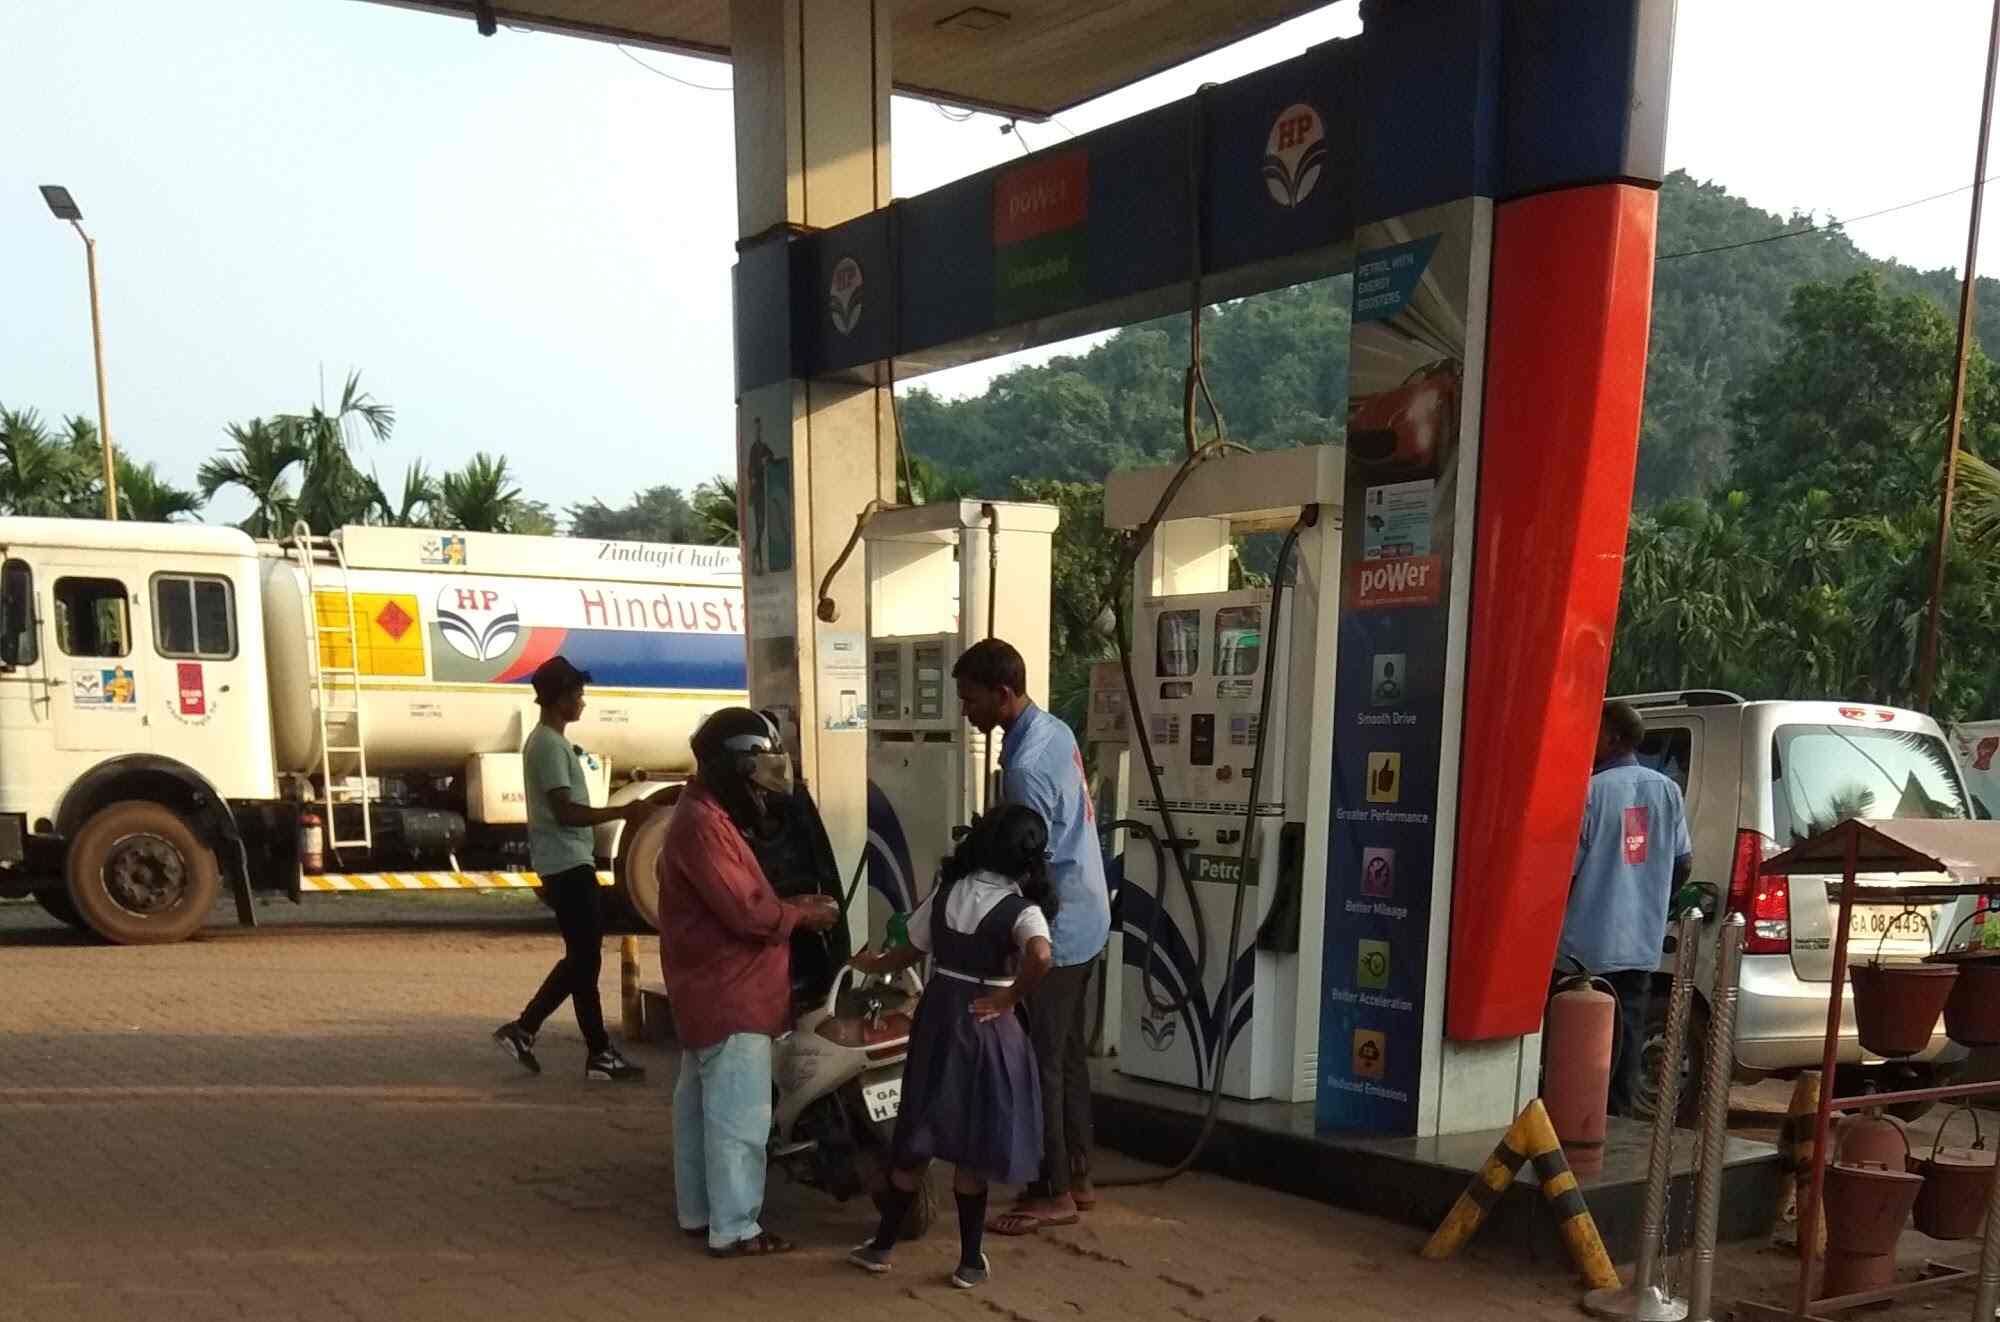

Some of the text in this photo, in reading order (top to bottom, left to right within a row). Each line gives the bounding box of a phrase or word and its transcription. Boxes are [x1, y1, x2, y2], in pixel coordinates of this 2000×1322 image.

[1279, 112, 1312, 149] HP
[833, 270, 861, 288] HP
[598, 542, 675, 568] Zindagi
[1360, 561, 1431, 598] power
[454, 588, 498, 611] HP
[1358, 711, 1417, 725] Smooth Drive
[1336, 808, 1429, 824] Greater Performance
[1345, 898, 1408, 920] Better Mileage
[1851, 914, 1867, 932] GA
[1870, 914, 1886, 932] 08
[1332, 987, 1413, 1012] Better Acceleration
[877, 1087, 898, 1100] GA
[1328, 1074, 1408, 1103] Reduced Emissions
[875, 1106, 888, 1119] H
